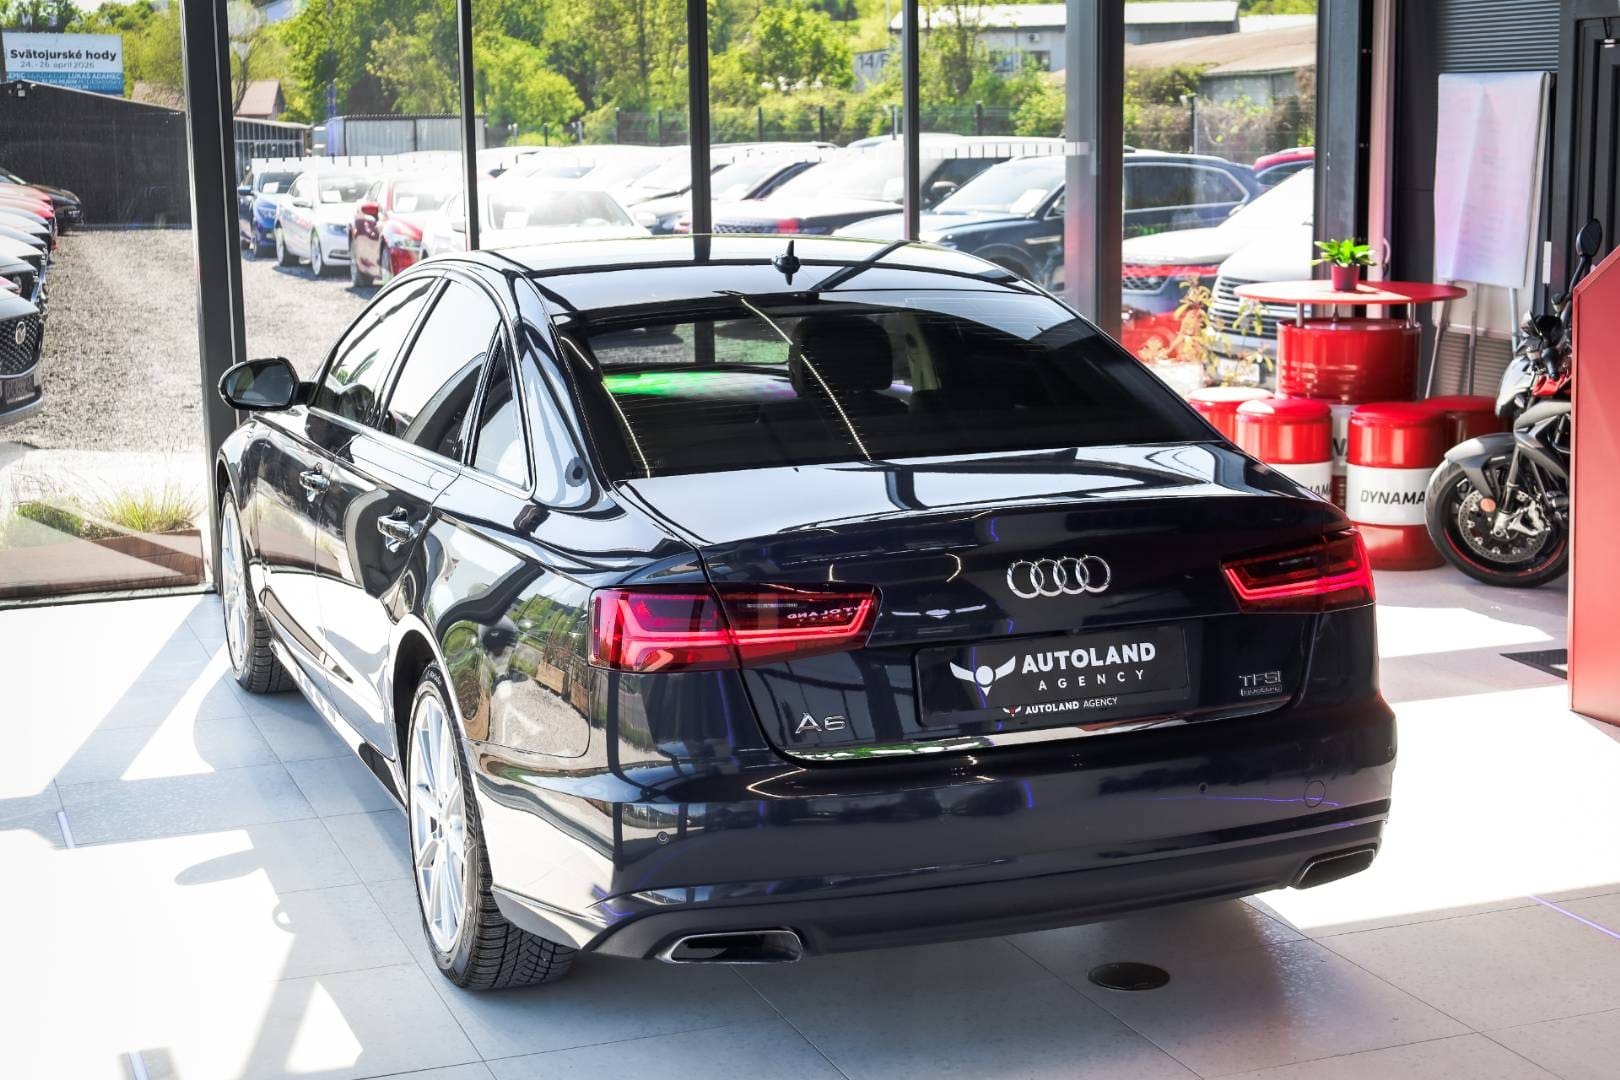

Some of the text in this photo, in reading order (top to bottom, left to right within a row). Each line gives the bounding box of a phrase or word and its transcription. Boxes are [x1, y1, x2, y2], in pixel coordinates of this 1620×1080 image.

[10, 49, 117, 61] Svätojurské hody
[53, 61, 72, 70] april
[73, 61, 95, 69] 2026
[1022, 642, 1156, 674] AUTOLAND
[1038, 669, 1145, 691] AGENCY
[1025, 697, 1119, 715] AUTOLAND AGENCY
[795, 712, 847, 734] A6
